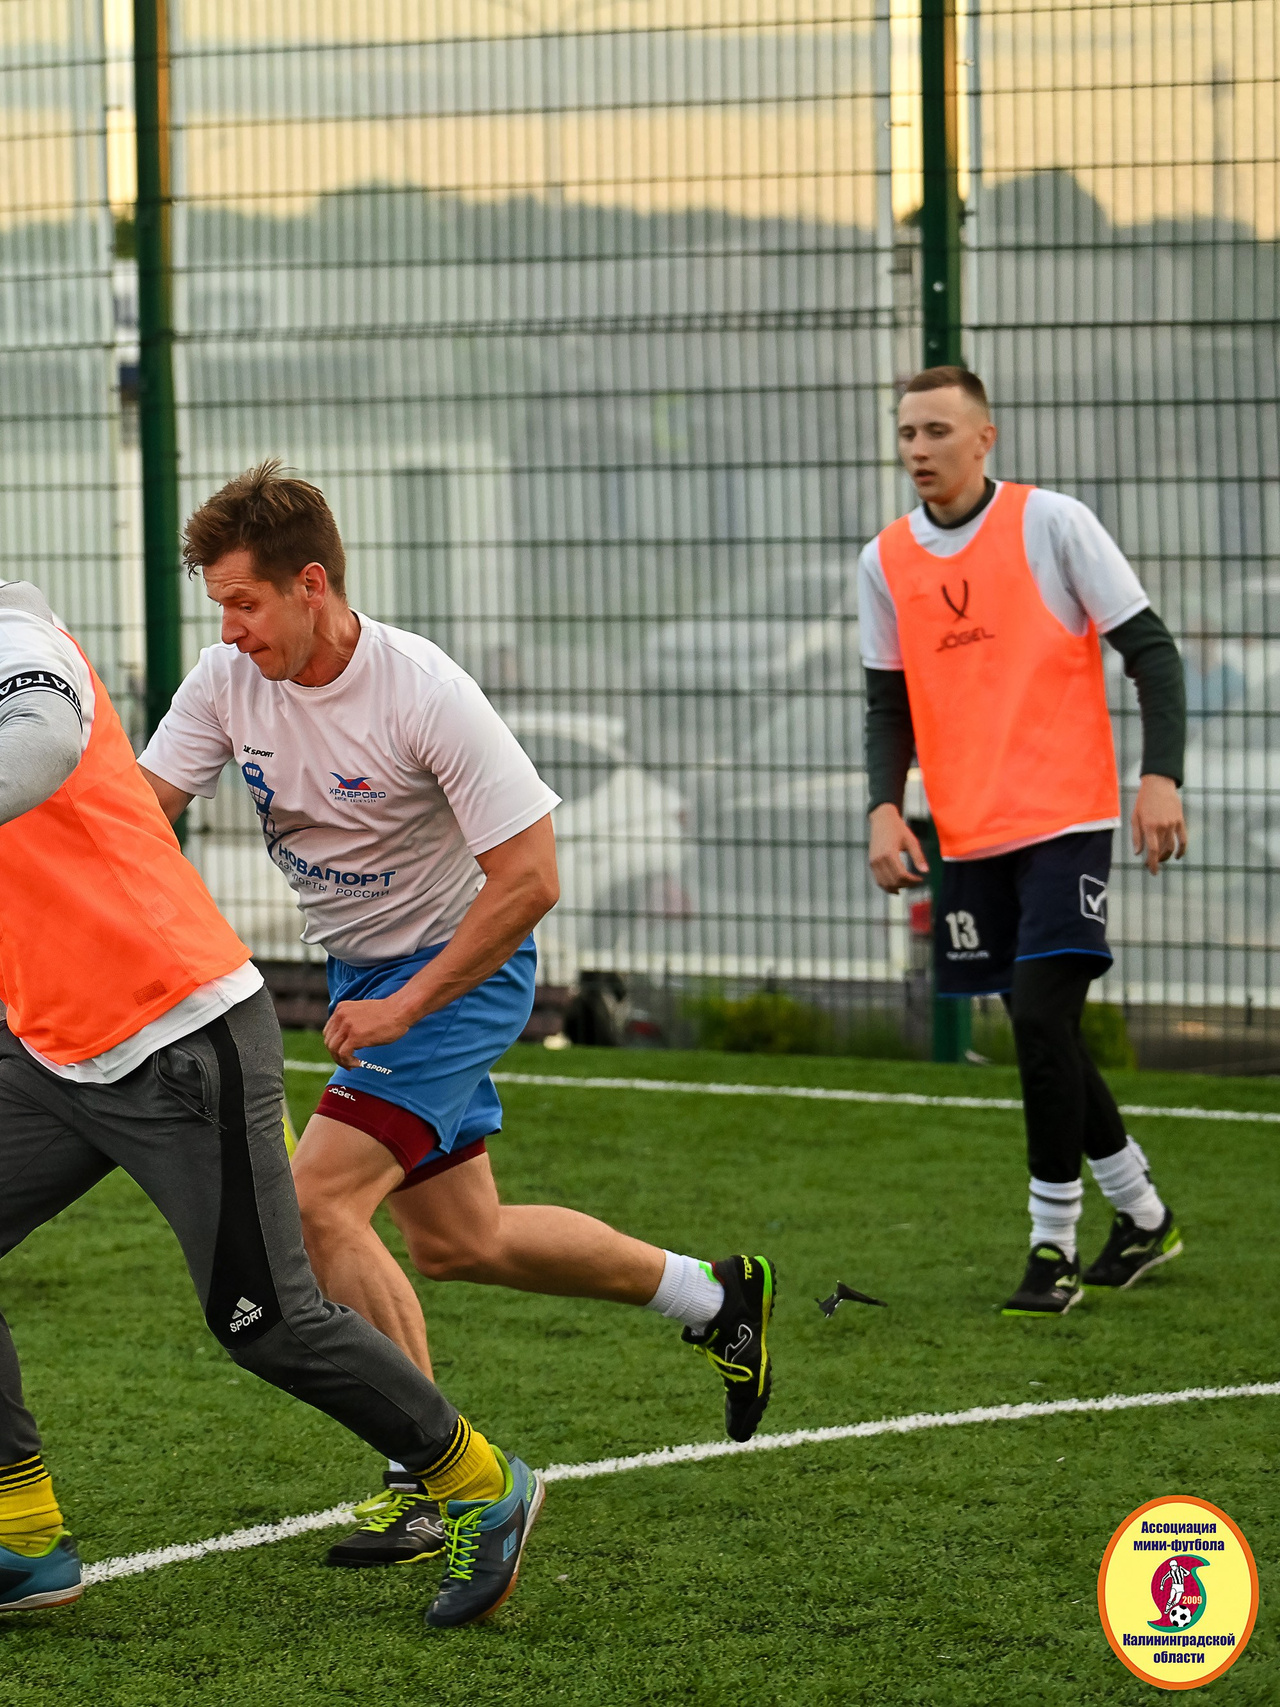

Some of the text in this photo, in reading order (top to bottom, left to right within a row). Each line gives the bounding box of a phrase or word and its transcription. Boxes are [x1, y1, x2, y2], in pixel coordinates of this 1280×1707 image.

[251, 749, 274, 758] SPORT
[329, 787, 387, 799] ХРАБРОВО
[278, 843, 397, 887] НОВАПОРТ
[335, 887, 390, 899] РОССИИ
[945, 910, 979, 950] 13
[365, 1062, 393, 1075] SPORT
[229, 1306, 263, 1333] SPORT
